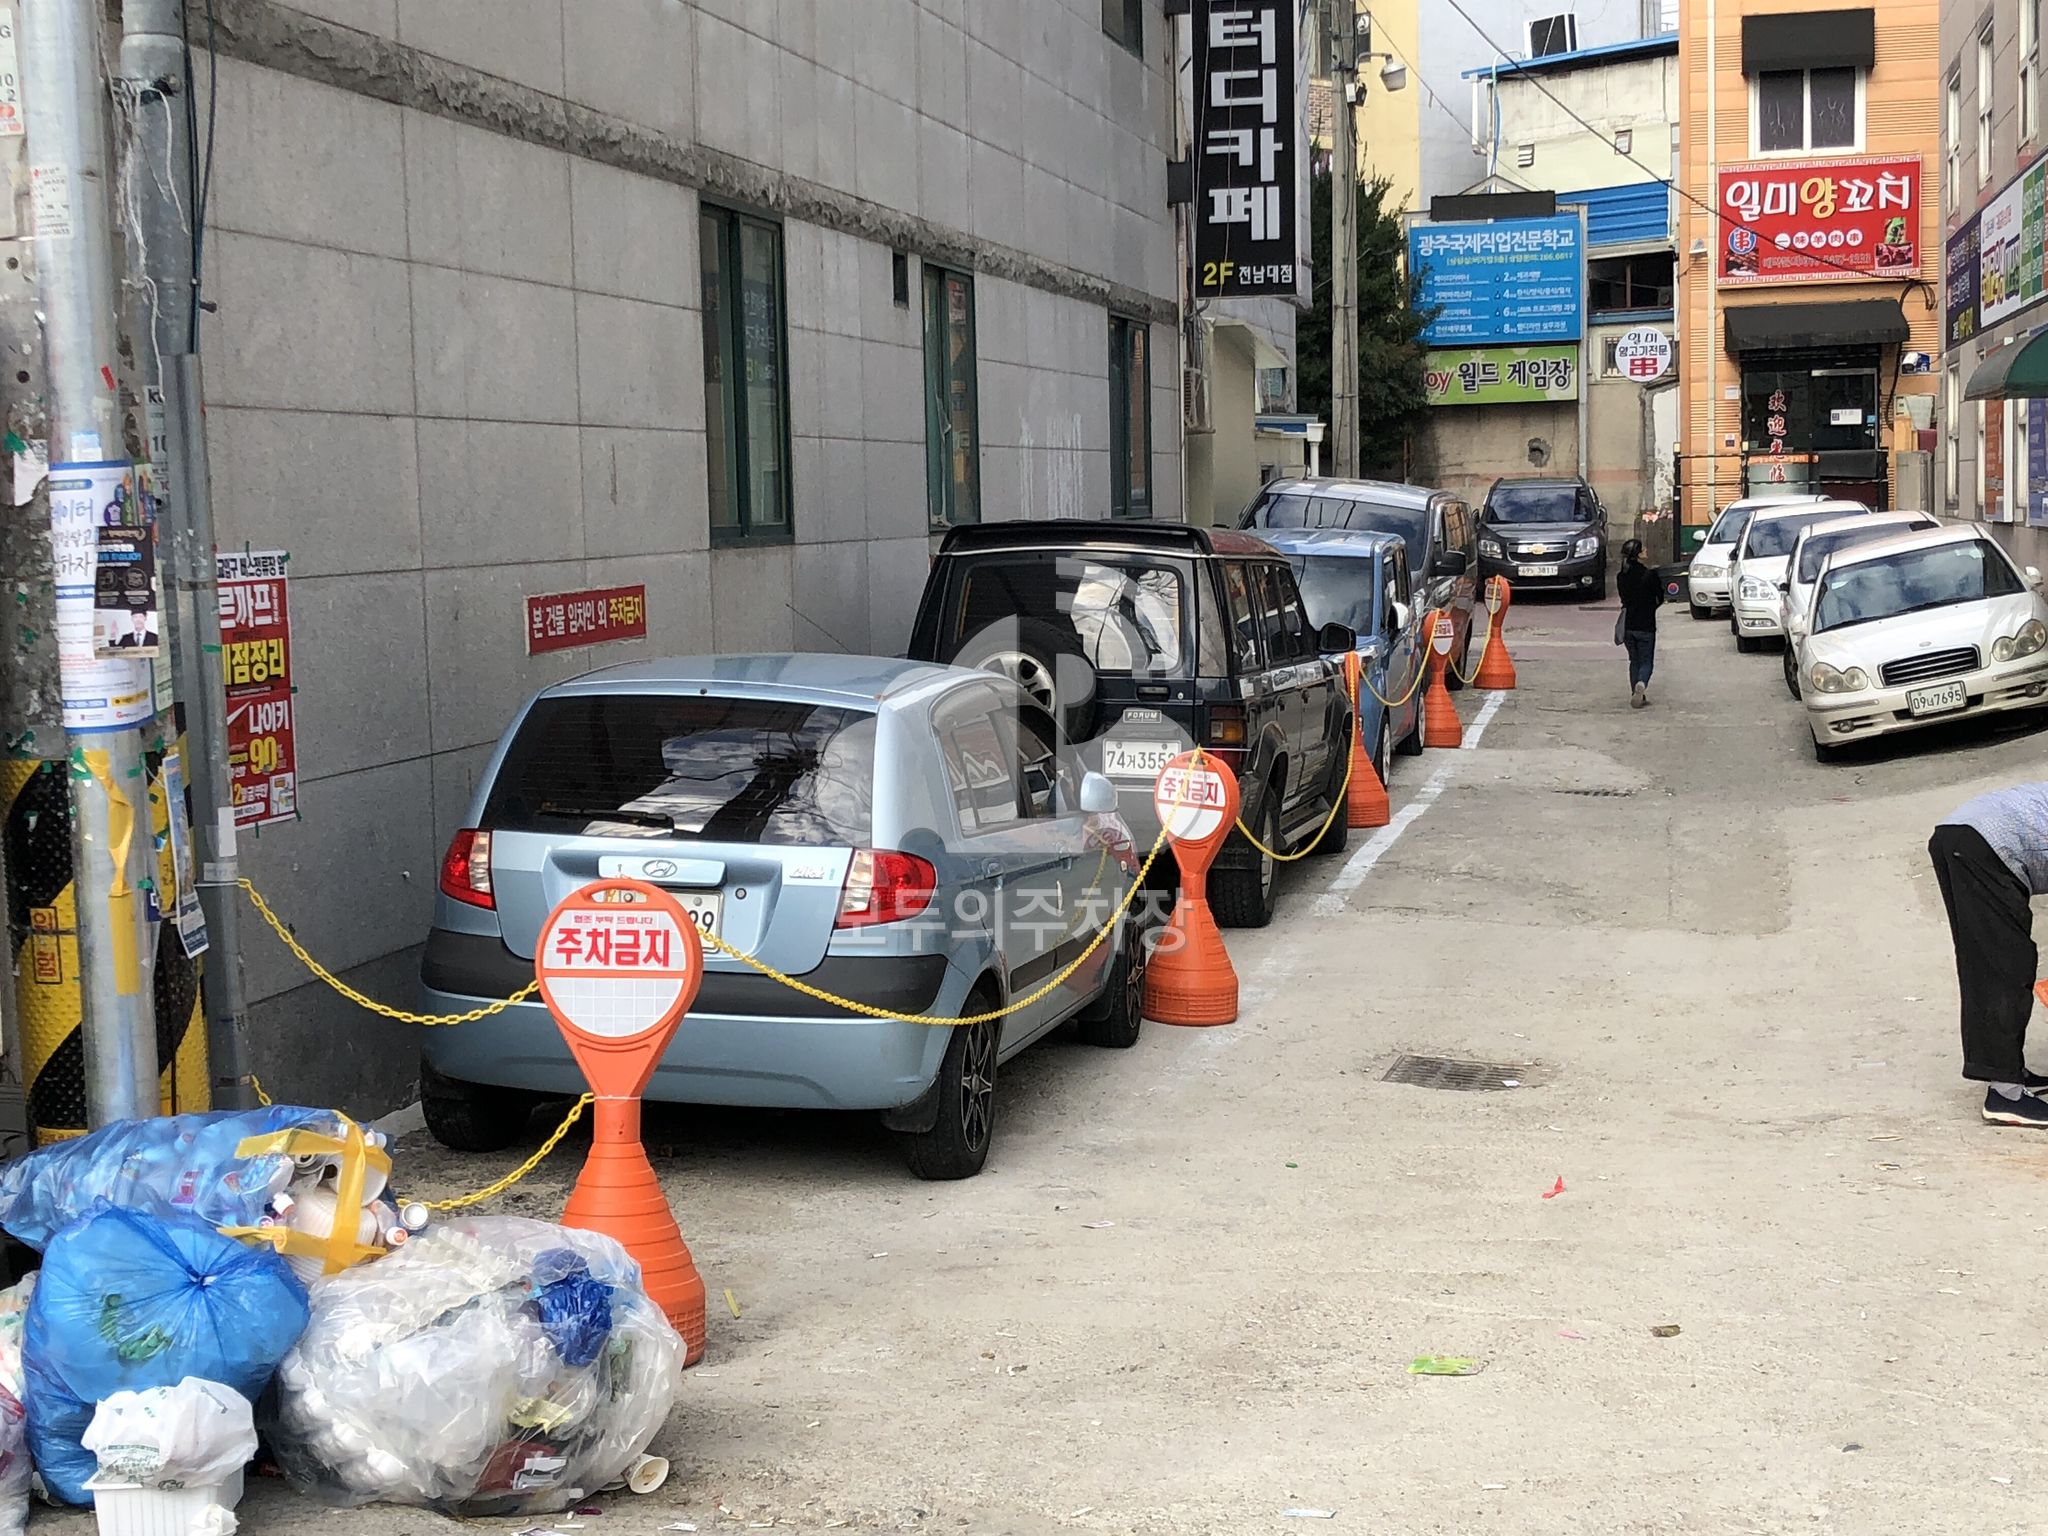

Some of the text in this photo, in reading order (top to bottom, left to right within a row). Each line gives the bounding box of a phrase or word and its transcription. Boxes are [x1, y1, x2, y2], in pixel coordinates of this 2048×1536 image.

[1726, 171, 1911, 222] 일미양꼬치
[1417, 229, 1575, 257] 광주국제직업전문학교
[1203, 262, 1293, 286] 2F 전남대점
[1619, 345, 1667, 357] 양고기전문
[1458, 362, 1499, 391] 월드
[1507, 359, 1571, 388] 게임장
[533, 594, 642, 638] 본 건물 임차인 외 주차금지
[249, 700, 289, 734] 나이키
[1127, 711, 1158, 719] FORUM
[250, 736, 277, 774] 90
[1163, 776, 1219, 804] 주차금지
[556, 927, 669, 967] 주차금지
